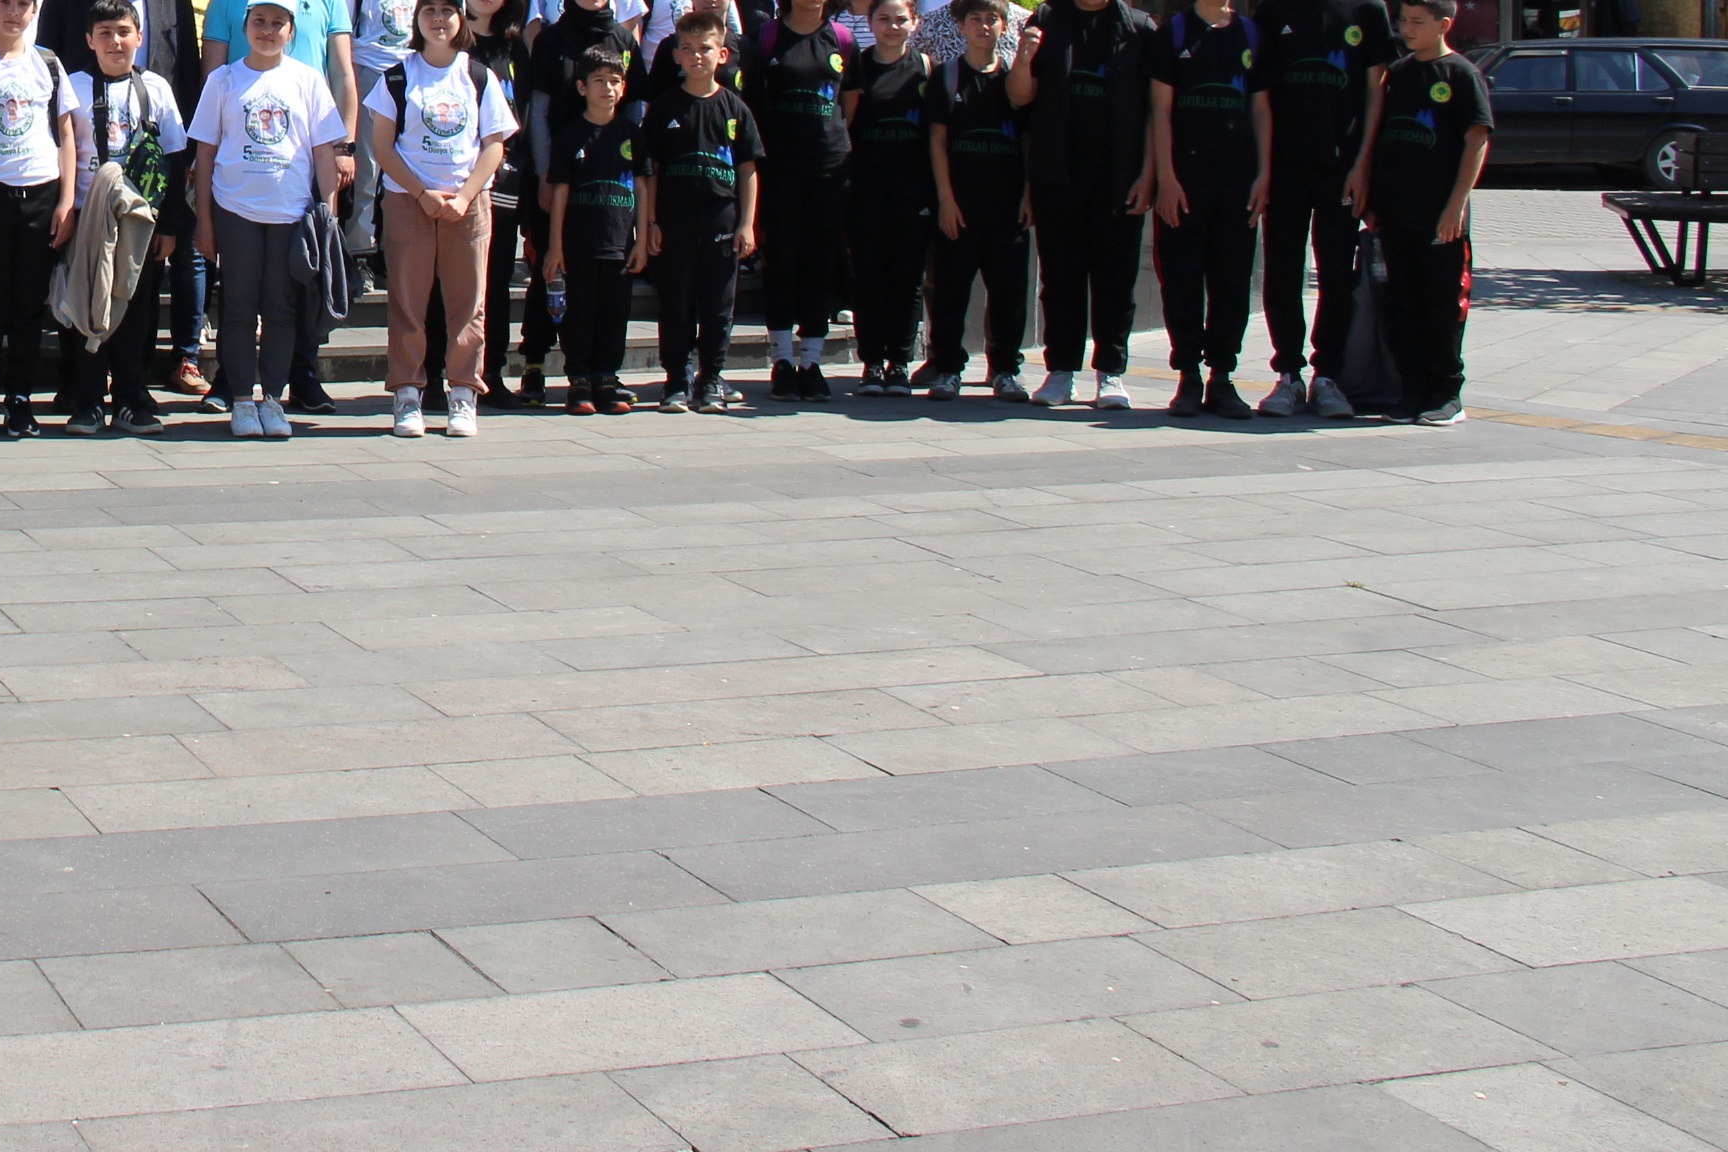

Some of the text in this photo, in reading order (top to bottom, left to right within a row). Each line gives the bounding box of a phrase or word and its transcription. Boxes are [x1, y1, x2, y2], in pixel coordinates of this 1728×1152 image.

[422, 136, 431, 151] 5
[243, 145, 252, 160] 5
[88, 156, 98, 172] 5
